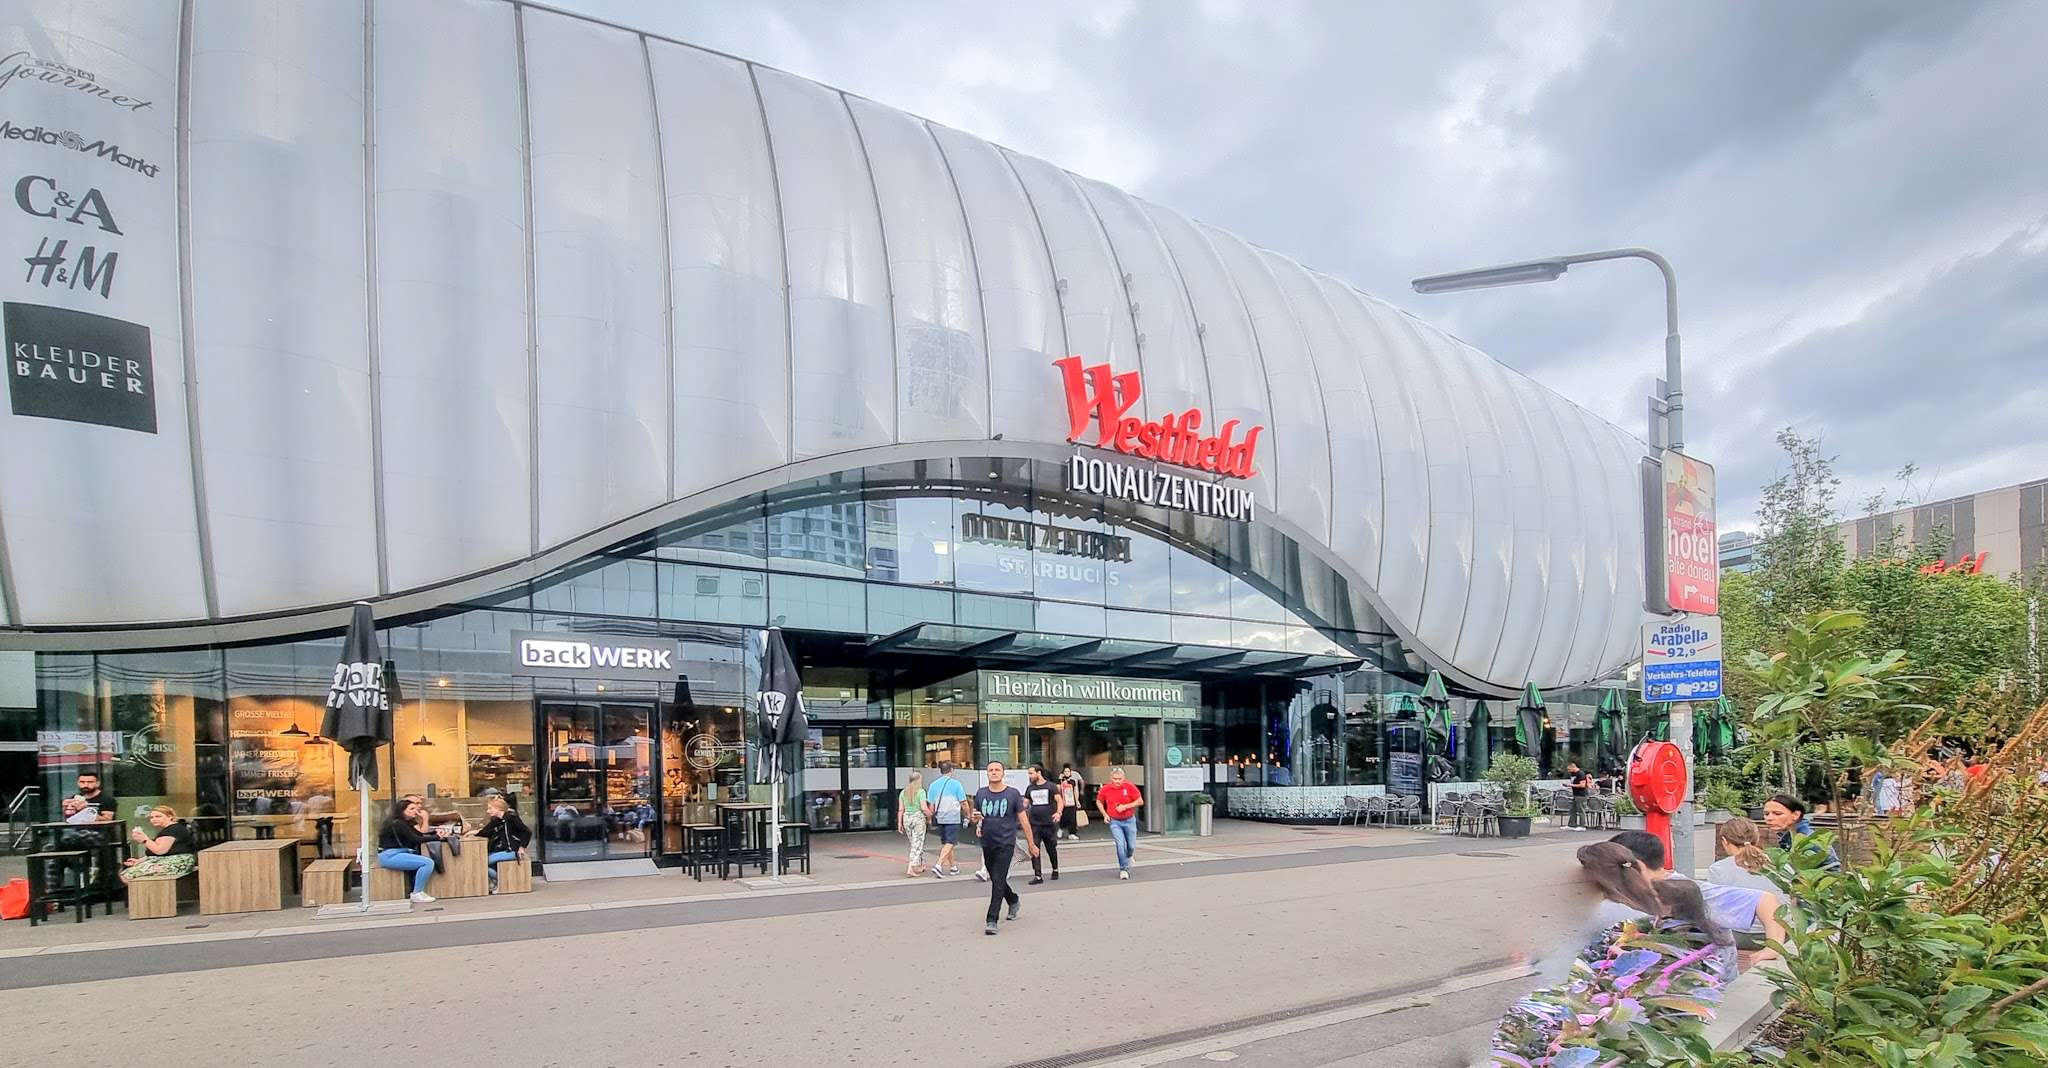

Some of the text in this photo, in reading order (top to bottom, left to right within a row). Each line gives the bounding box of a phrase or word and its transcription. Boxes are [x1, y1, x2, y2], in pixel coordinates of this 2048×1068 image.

[79, 140, 159, 178] Markt
[14, 175, 124, 236] C&A
[24, 237, 119, 300] H&M
[14, 342, 142, 377] KLEIDER
[16, 360, 144, 395] BAUER
[1052, 354, 1264, 480] Westfield
[1667, 518, 1714, 566] hotel
[1669, 559, 1714, 582] alte donau
[1651, 629, 1708, 646] Arabella
[1661, 623, 1691, 634] Radio
[1667, 647, 1697, 658] 92,9
[993, 675, 1182, 702] Herzlich willkommen
[1646, 669, 1718, 680] Verkehrs-Telefon
